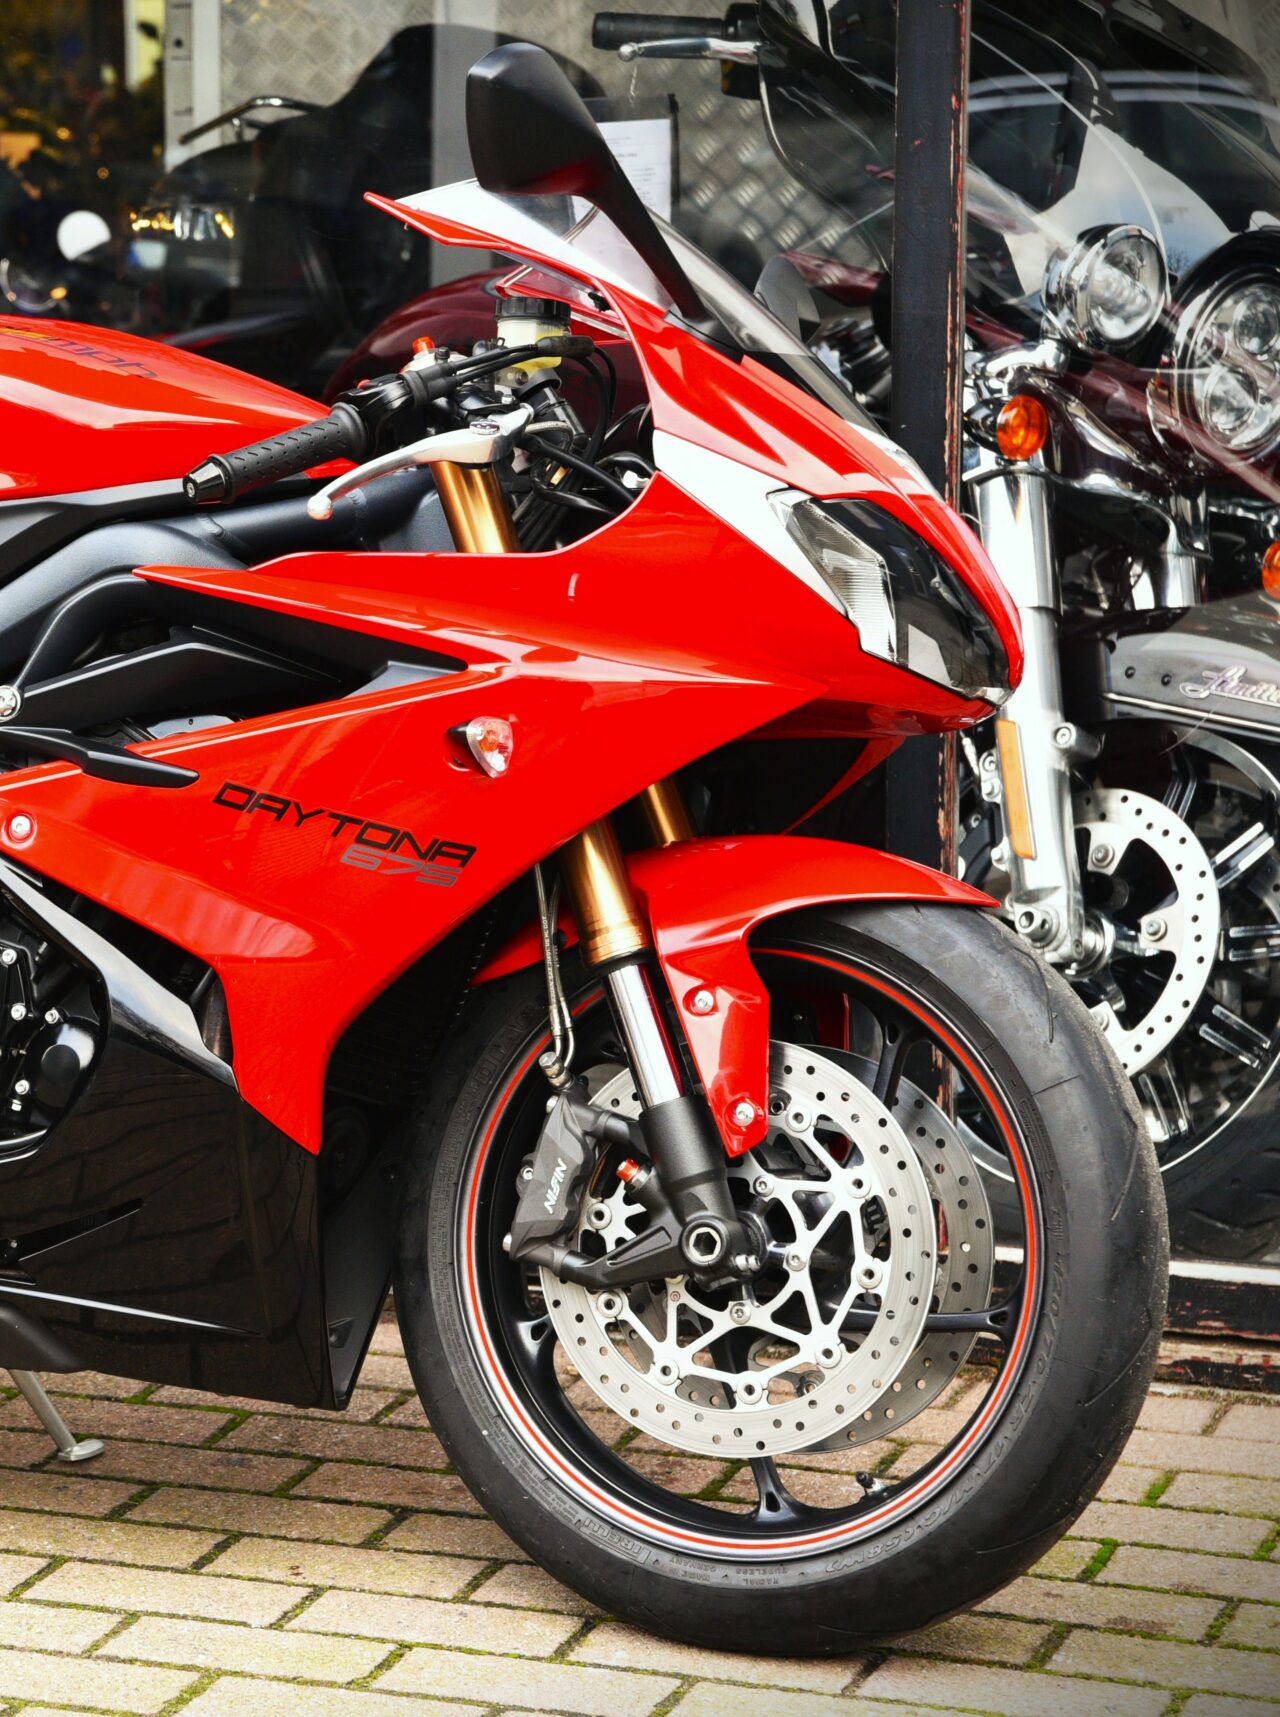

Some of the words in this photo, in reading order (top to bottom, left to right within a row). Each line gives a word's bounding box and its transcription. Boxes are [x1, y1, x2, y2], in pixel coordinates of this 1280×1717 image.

[213, 783, 477, 868] DAYTONA
[340, 845, 461, 887] 675
[544, 1157, 567, 1214] NISSIN
[576, 1514, 653, 1566] PIRELLI
[668, 1556, 718, 1575] GERMANY
[822, 1522, 920, 1575] (58W)
[735, 1565, 789, 1577] TUBELESS
